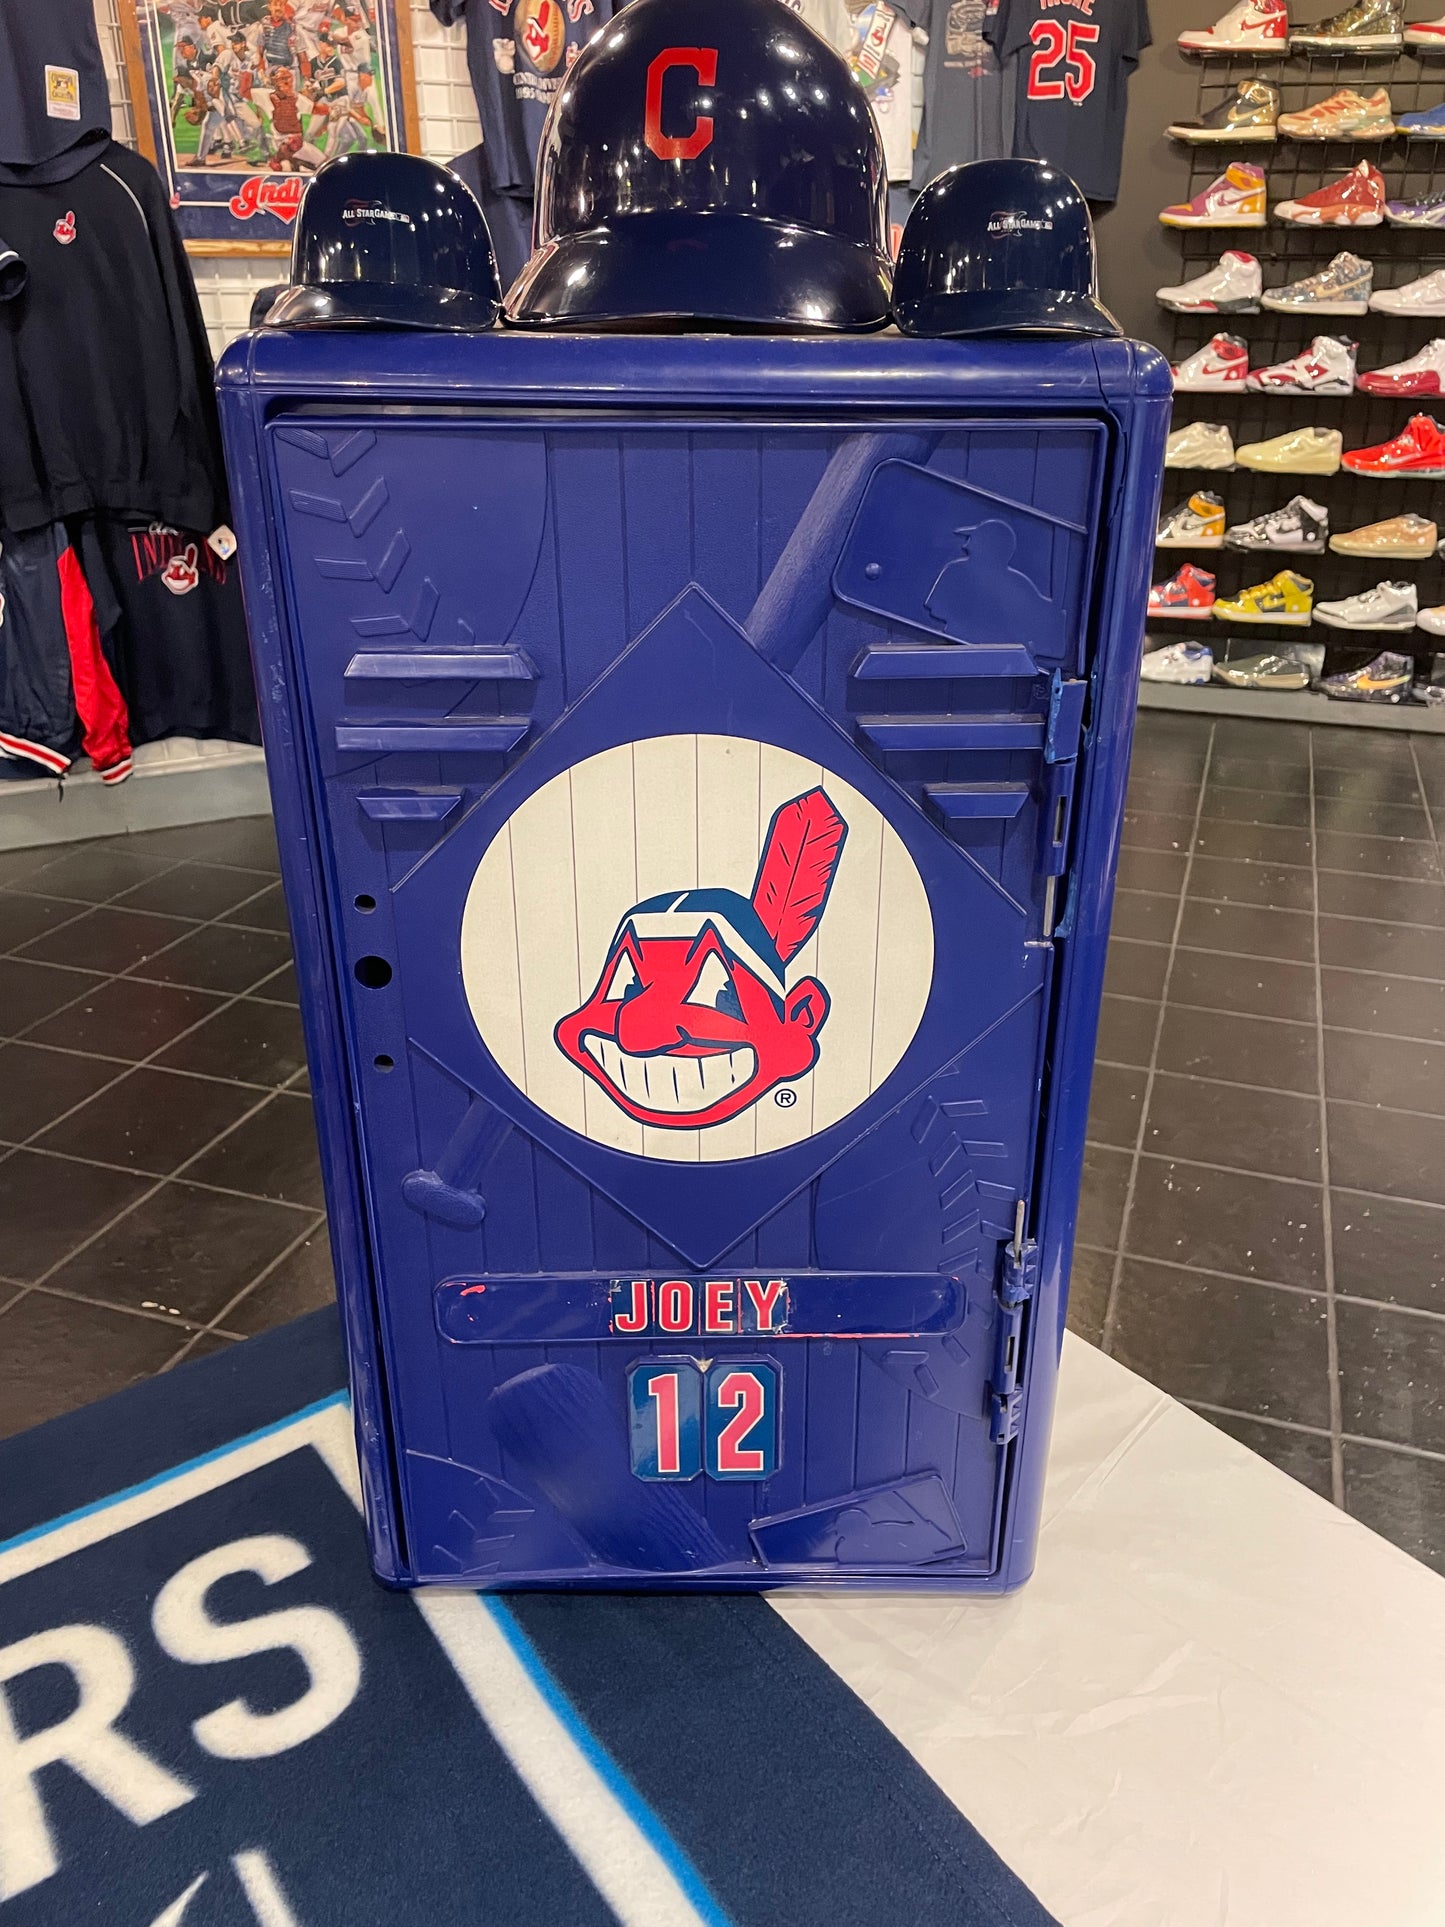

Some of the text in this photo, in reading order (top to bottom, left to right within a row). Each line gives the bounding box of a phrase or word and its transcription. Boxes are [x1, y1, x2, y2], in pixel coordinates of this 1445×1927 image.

[644, 46, 718, 160] C
[1027, 19, 1100, 102] 25
[614, 1280, 784, 1333] JOEY
[648, 1372, 765, 1473] 12
